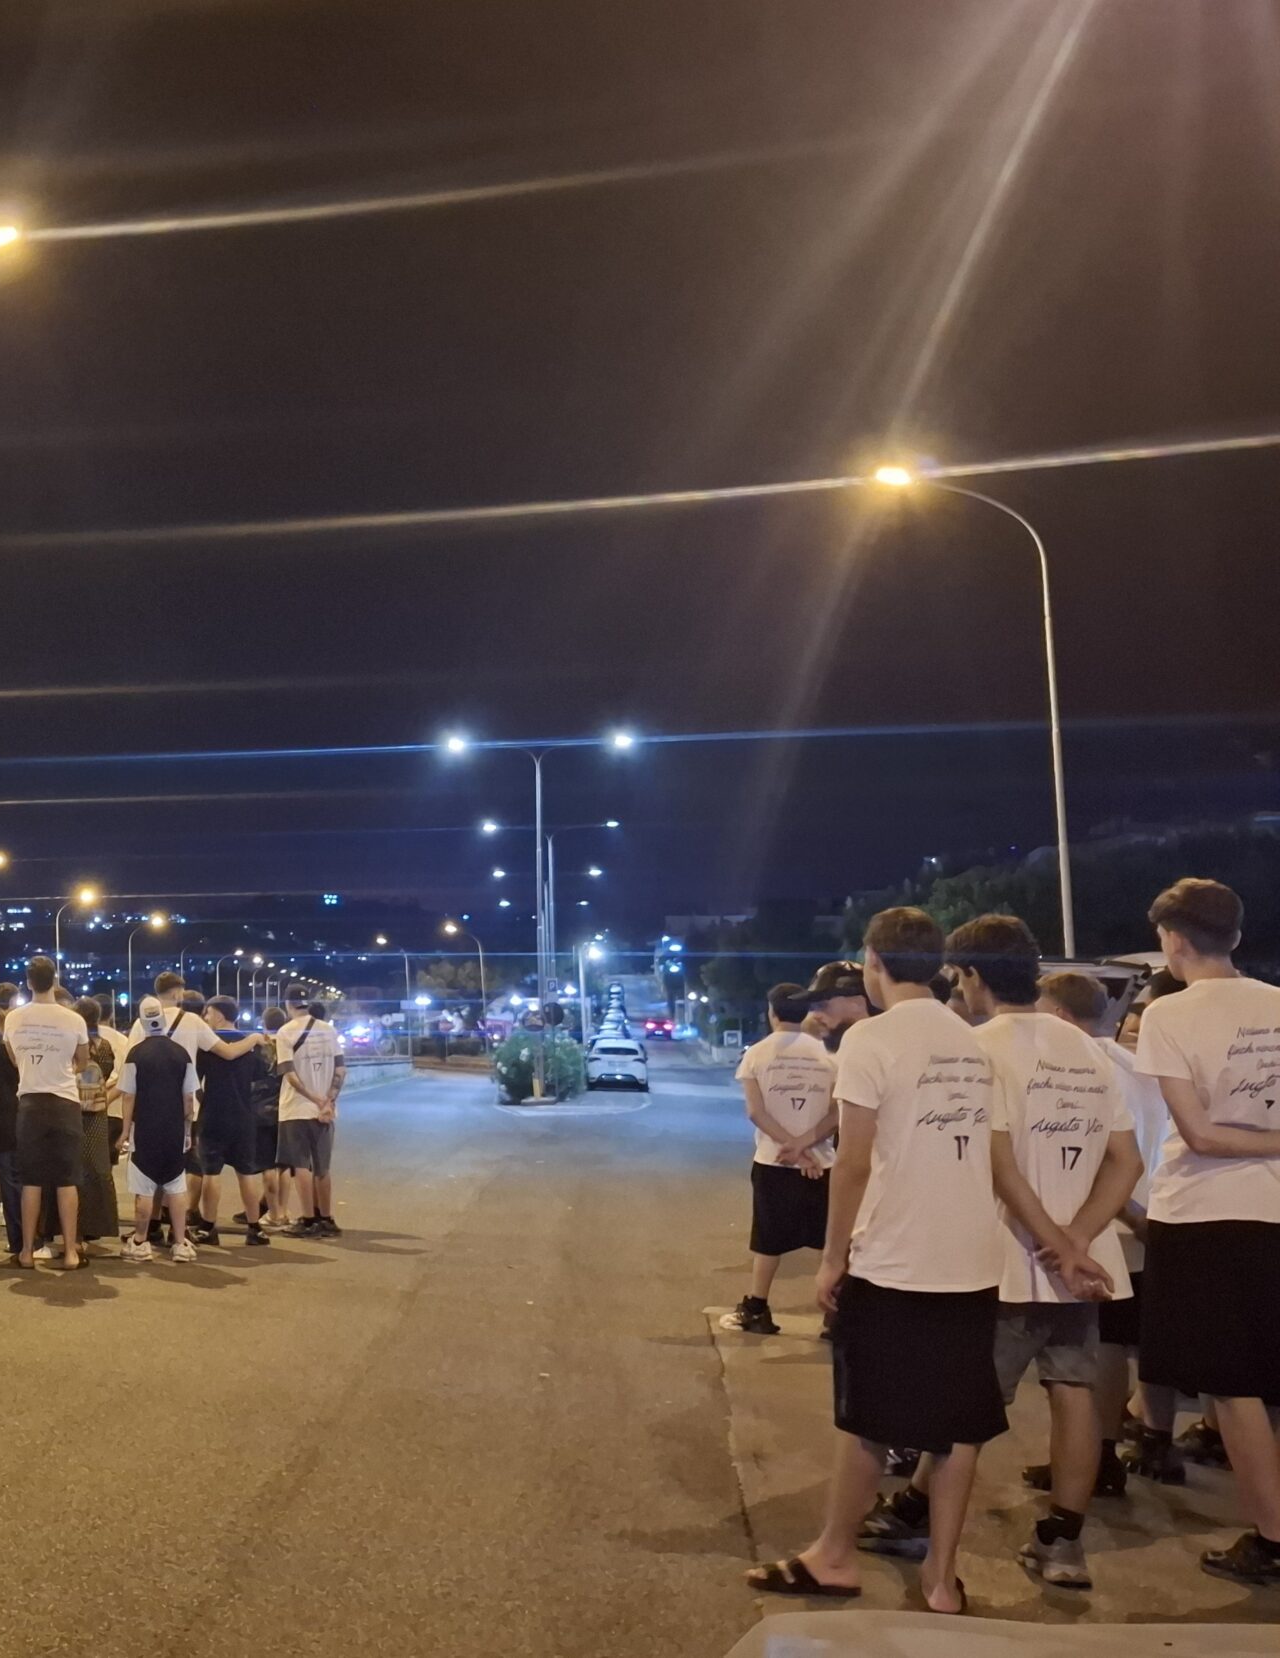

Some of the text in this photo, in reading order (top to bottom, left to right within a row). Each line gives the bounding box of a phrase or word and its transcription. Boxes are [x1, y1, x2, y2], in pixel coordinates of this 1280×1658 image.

[30, 1054, 44, 1065] 17
[312, 1062, 323, 1072] 17
[790, 1097, 807, 1111] 17
[1061, 1146, 1083, 1171] 17
